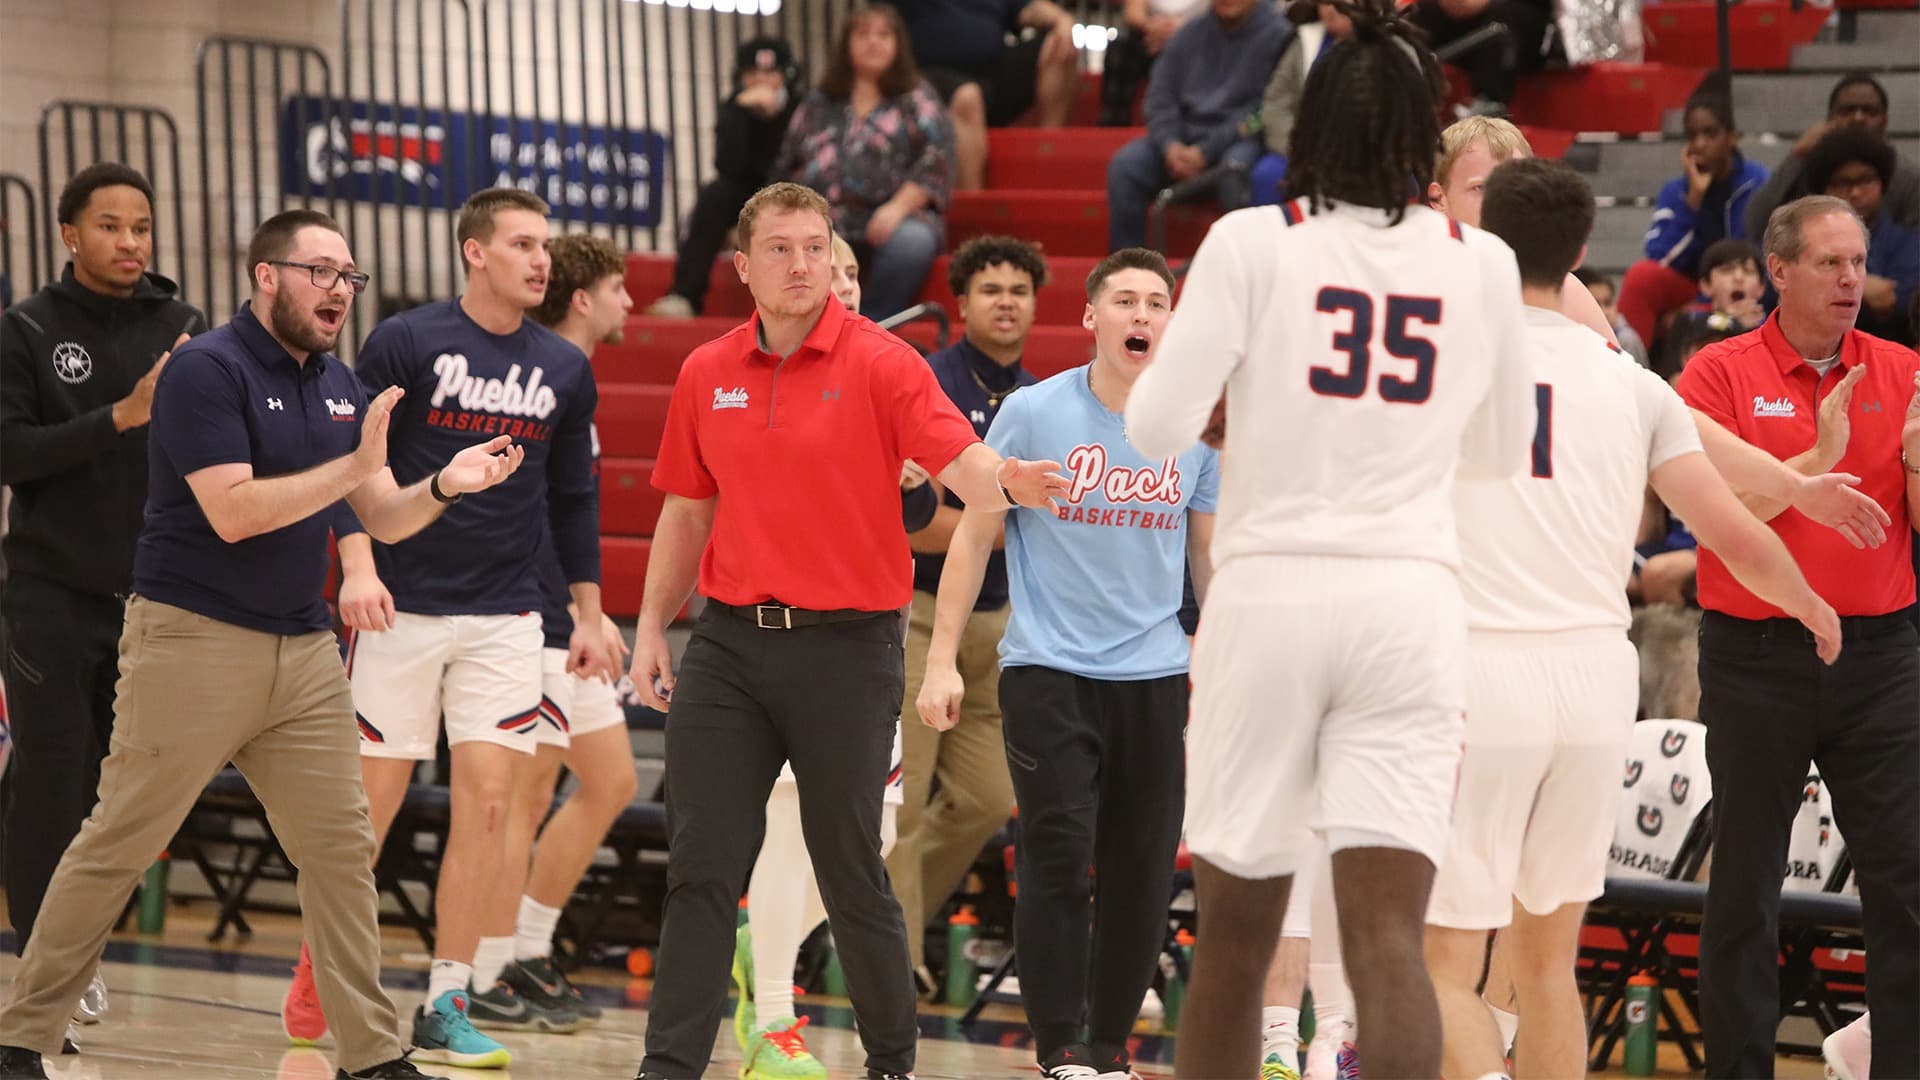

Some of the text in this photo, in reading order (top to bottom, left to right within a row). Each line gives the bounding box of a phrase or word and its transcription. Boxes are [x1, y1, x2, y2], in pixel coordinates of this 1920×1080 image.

[1309, 285, 1442, 404] 35
[430, 353, 557, 420] Pueblo
[713, 386, 750, 405] Pueblo
[1753, 396, 1795, 412] Pueblo
[427, 409, 549, 441] BASKETBALL
[1066, 442, 1183, 506] Pack
[1057, 506, 1181, 530] BASKETBALL
